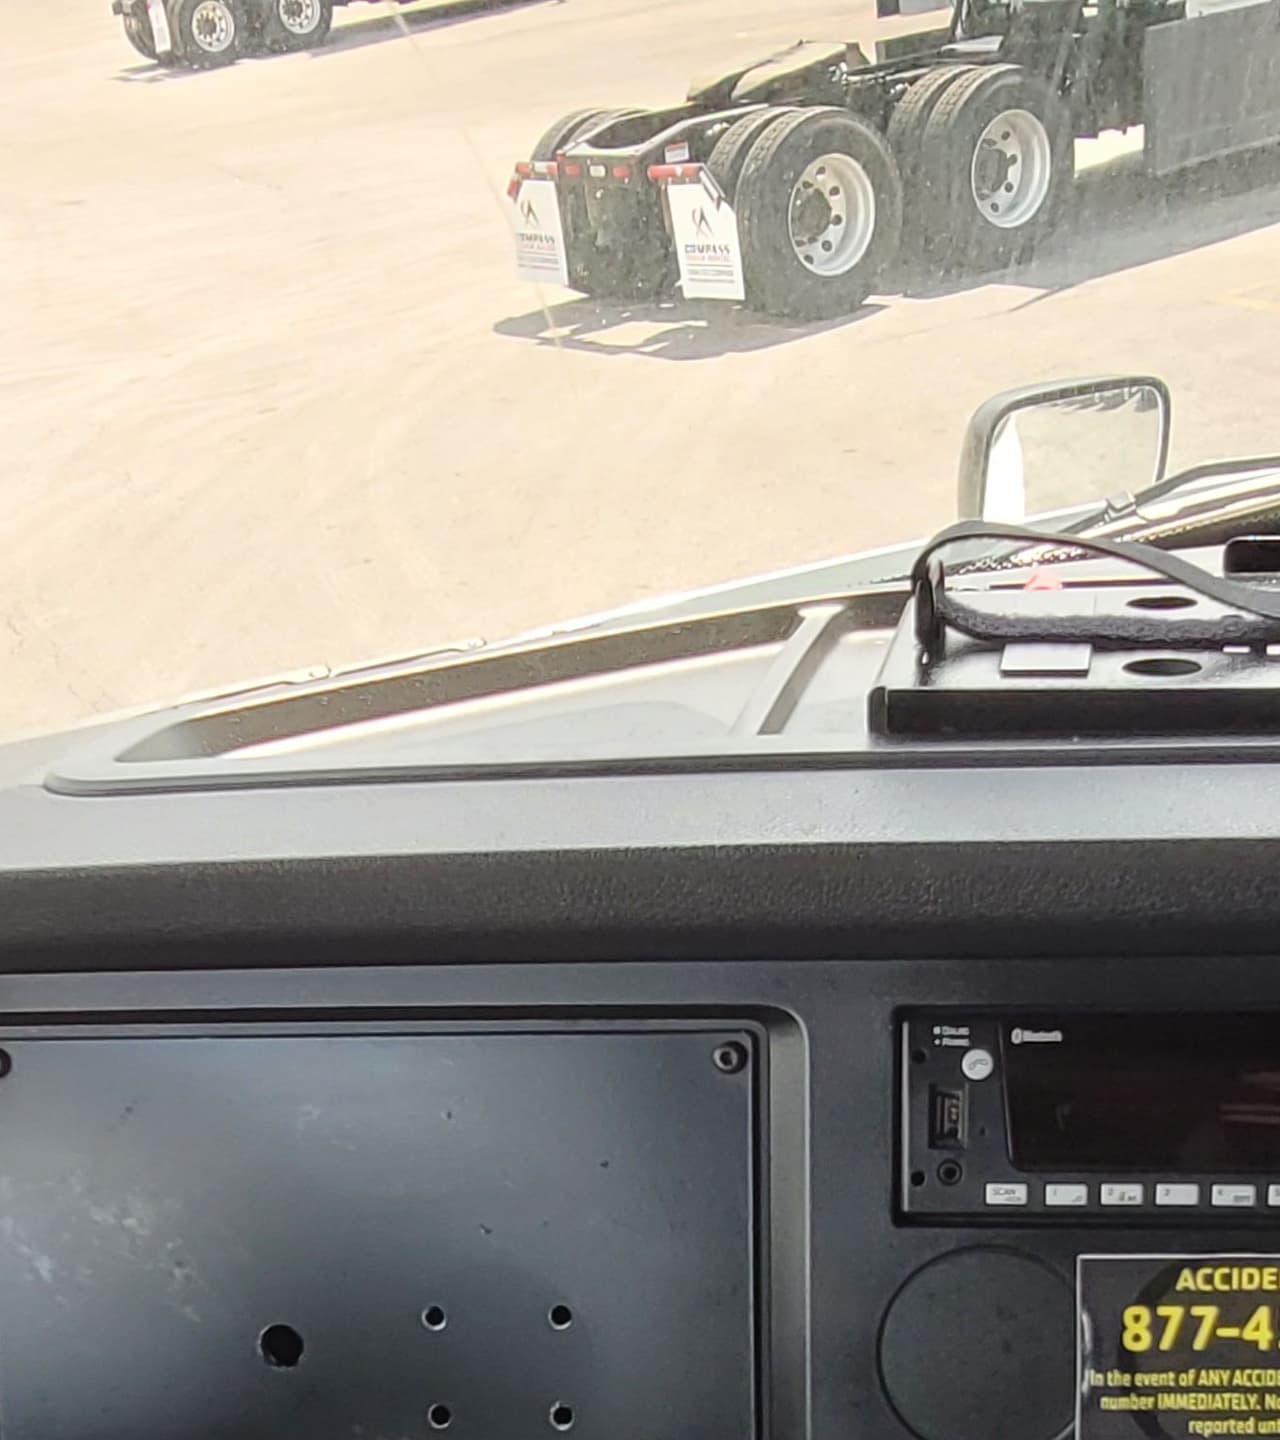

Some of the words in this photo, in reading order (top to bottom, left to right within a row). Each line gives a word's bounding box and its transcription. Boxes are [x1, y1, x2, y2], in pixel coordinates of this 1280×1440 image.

[1106, 1369, 1131, 1388] the
[1134, 1371, 1176, 1388] event
[1178, 1369, 1195, 1388] of
[1198, 1369, 1231, 1387] ANY
[1100, 1393, 1155, 1411] number
[1157, 1393, 1261, 1411] IMMEDIATELY.
[1188, 1417, 1256, 1439] reported
